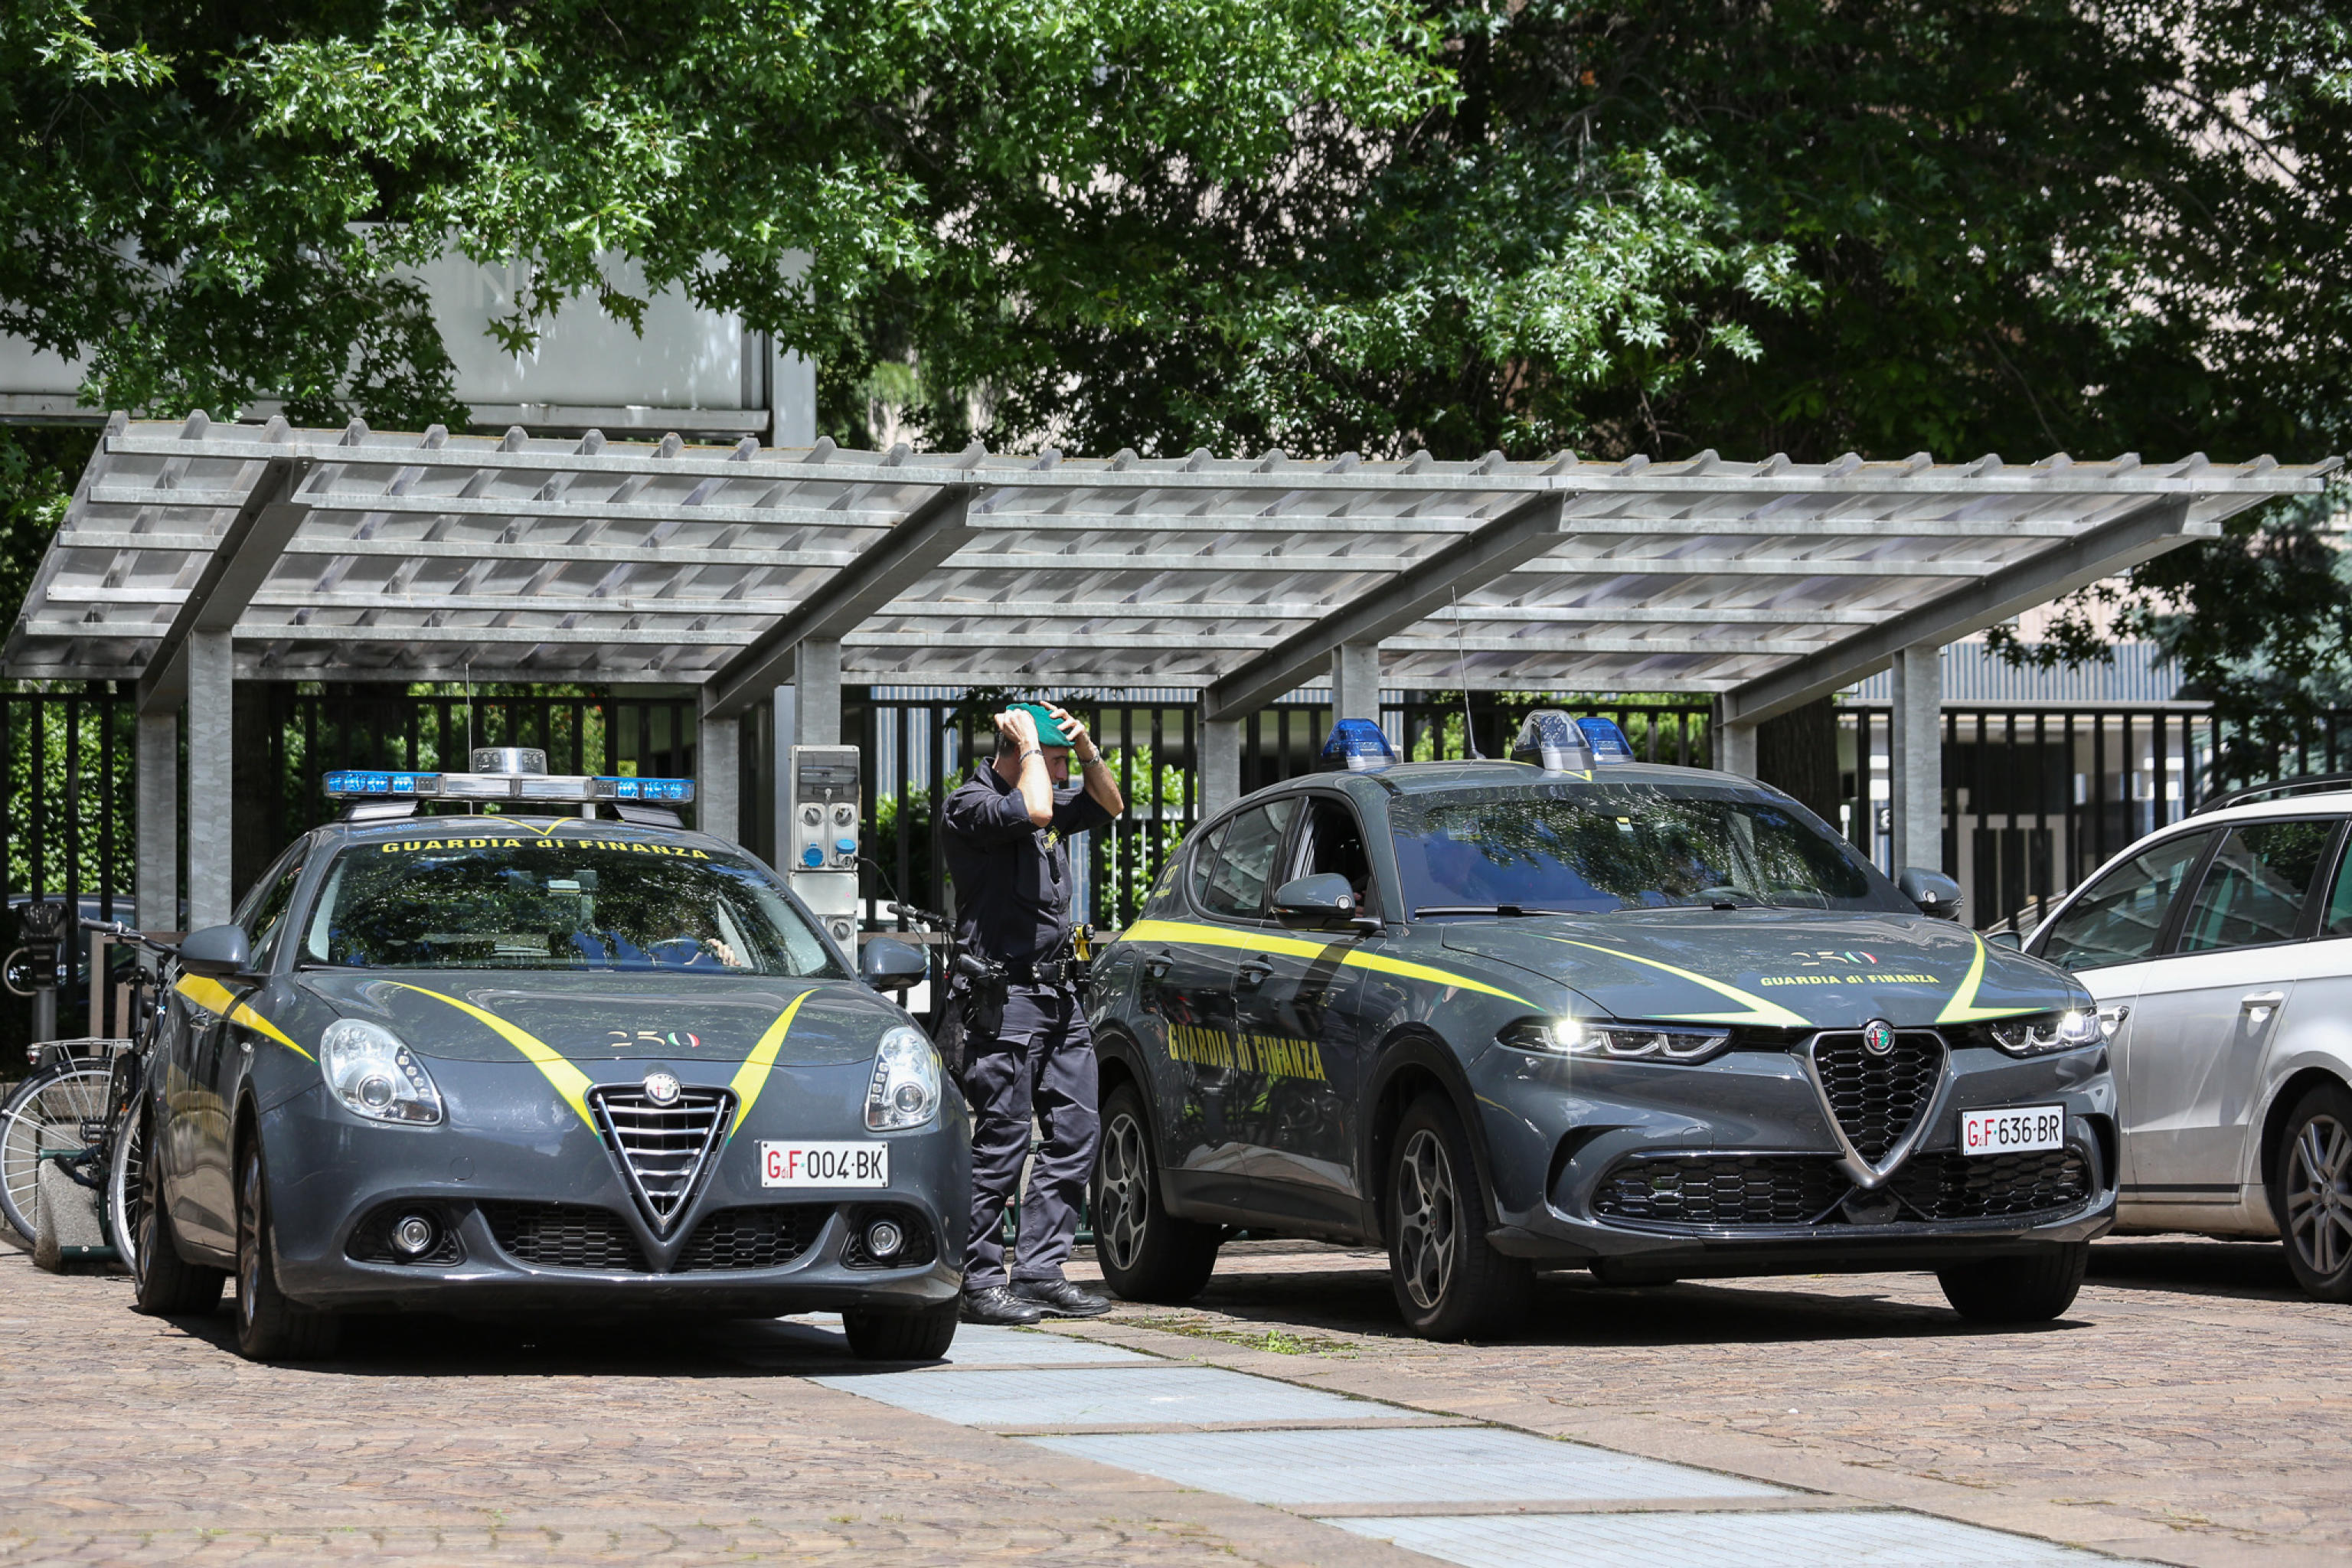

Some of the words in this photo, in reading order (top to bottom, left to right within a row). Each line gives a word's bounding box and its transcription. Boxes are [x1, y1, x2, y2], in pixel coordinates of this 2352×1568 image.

[382, 838, 522, 854] GUARDIA
[537, 839, 564, 848] di
[579, 840, 710, 860] FINANZA
[1760, 975, 1841, 986] GUARDIA
[1846, 975, 1864, 984] di
[1867, 975, 1940, 984] FINANZA
[1168, 1023, 1234, 1070] GUARDIA
[1236, 1034, 1253, 1072] di
[1253, 1035, 1325, 1080] FINANZA
